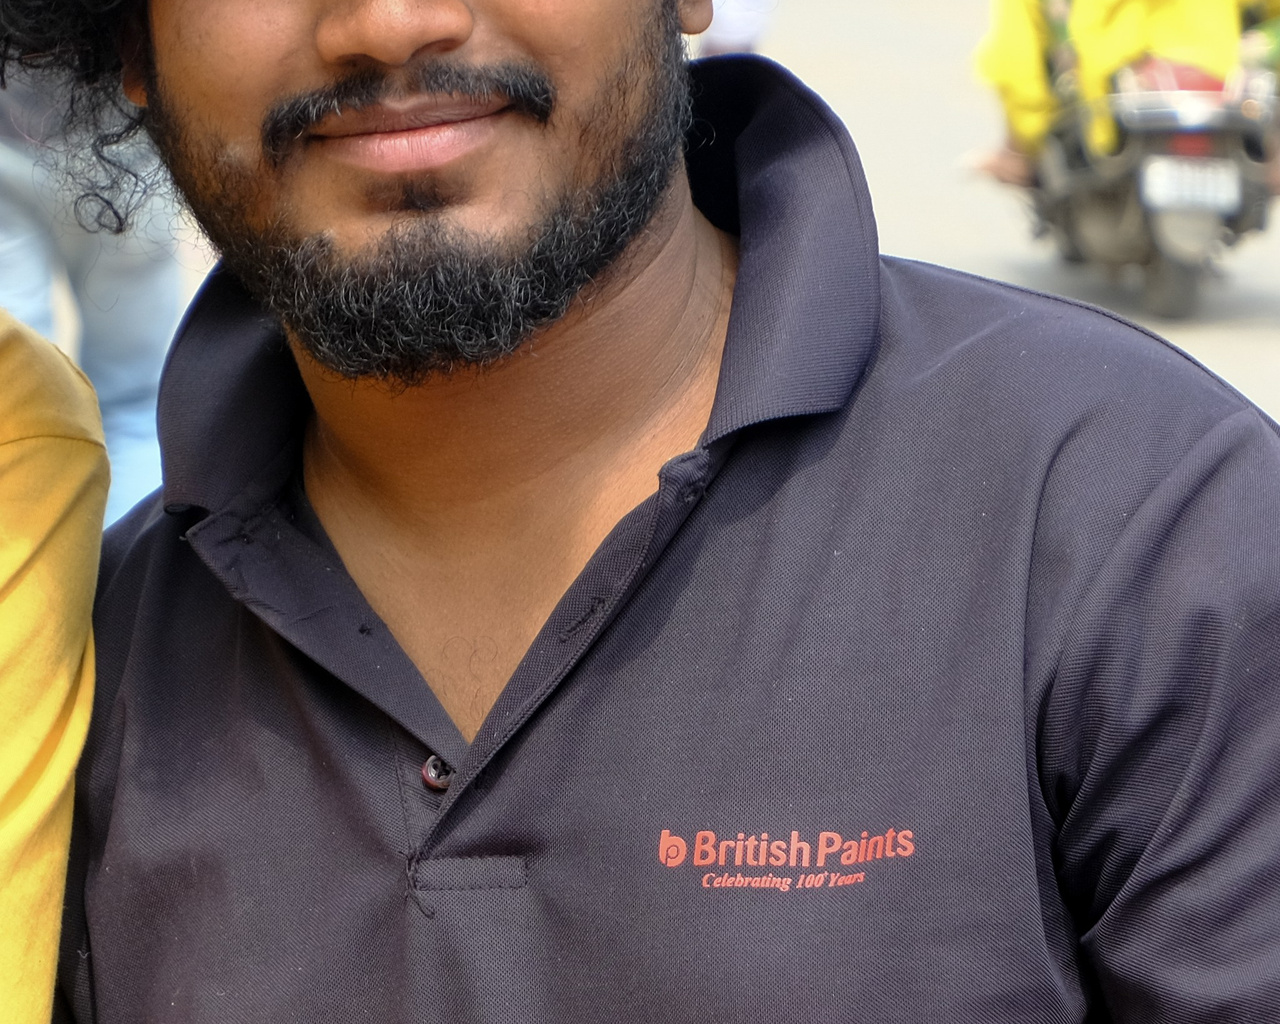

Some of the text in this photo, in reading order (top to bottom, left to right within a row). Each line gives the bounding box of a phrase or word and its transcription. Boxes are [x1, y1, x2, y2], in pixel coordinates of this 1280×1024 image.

[693, 830, 811, 867] British
[816, 828, 915, 867] Paints
[702, 873, 792, 892] Celebrating
[828, 872, 865, 887] Years
